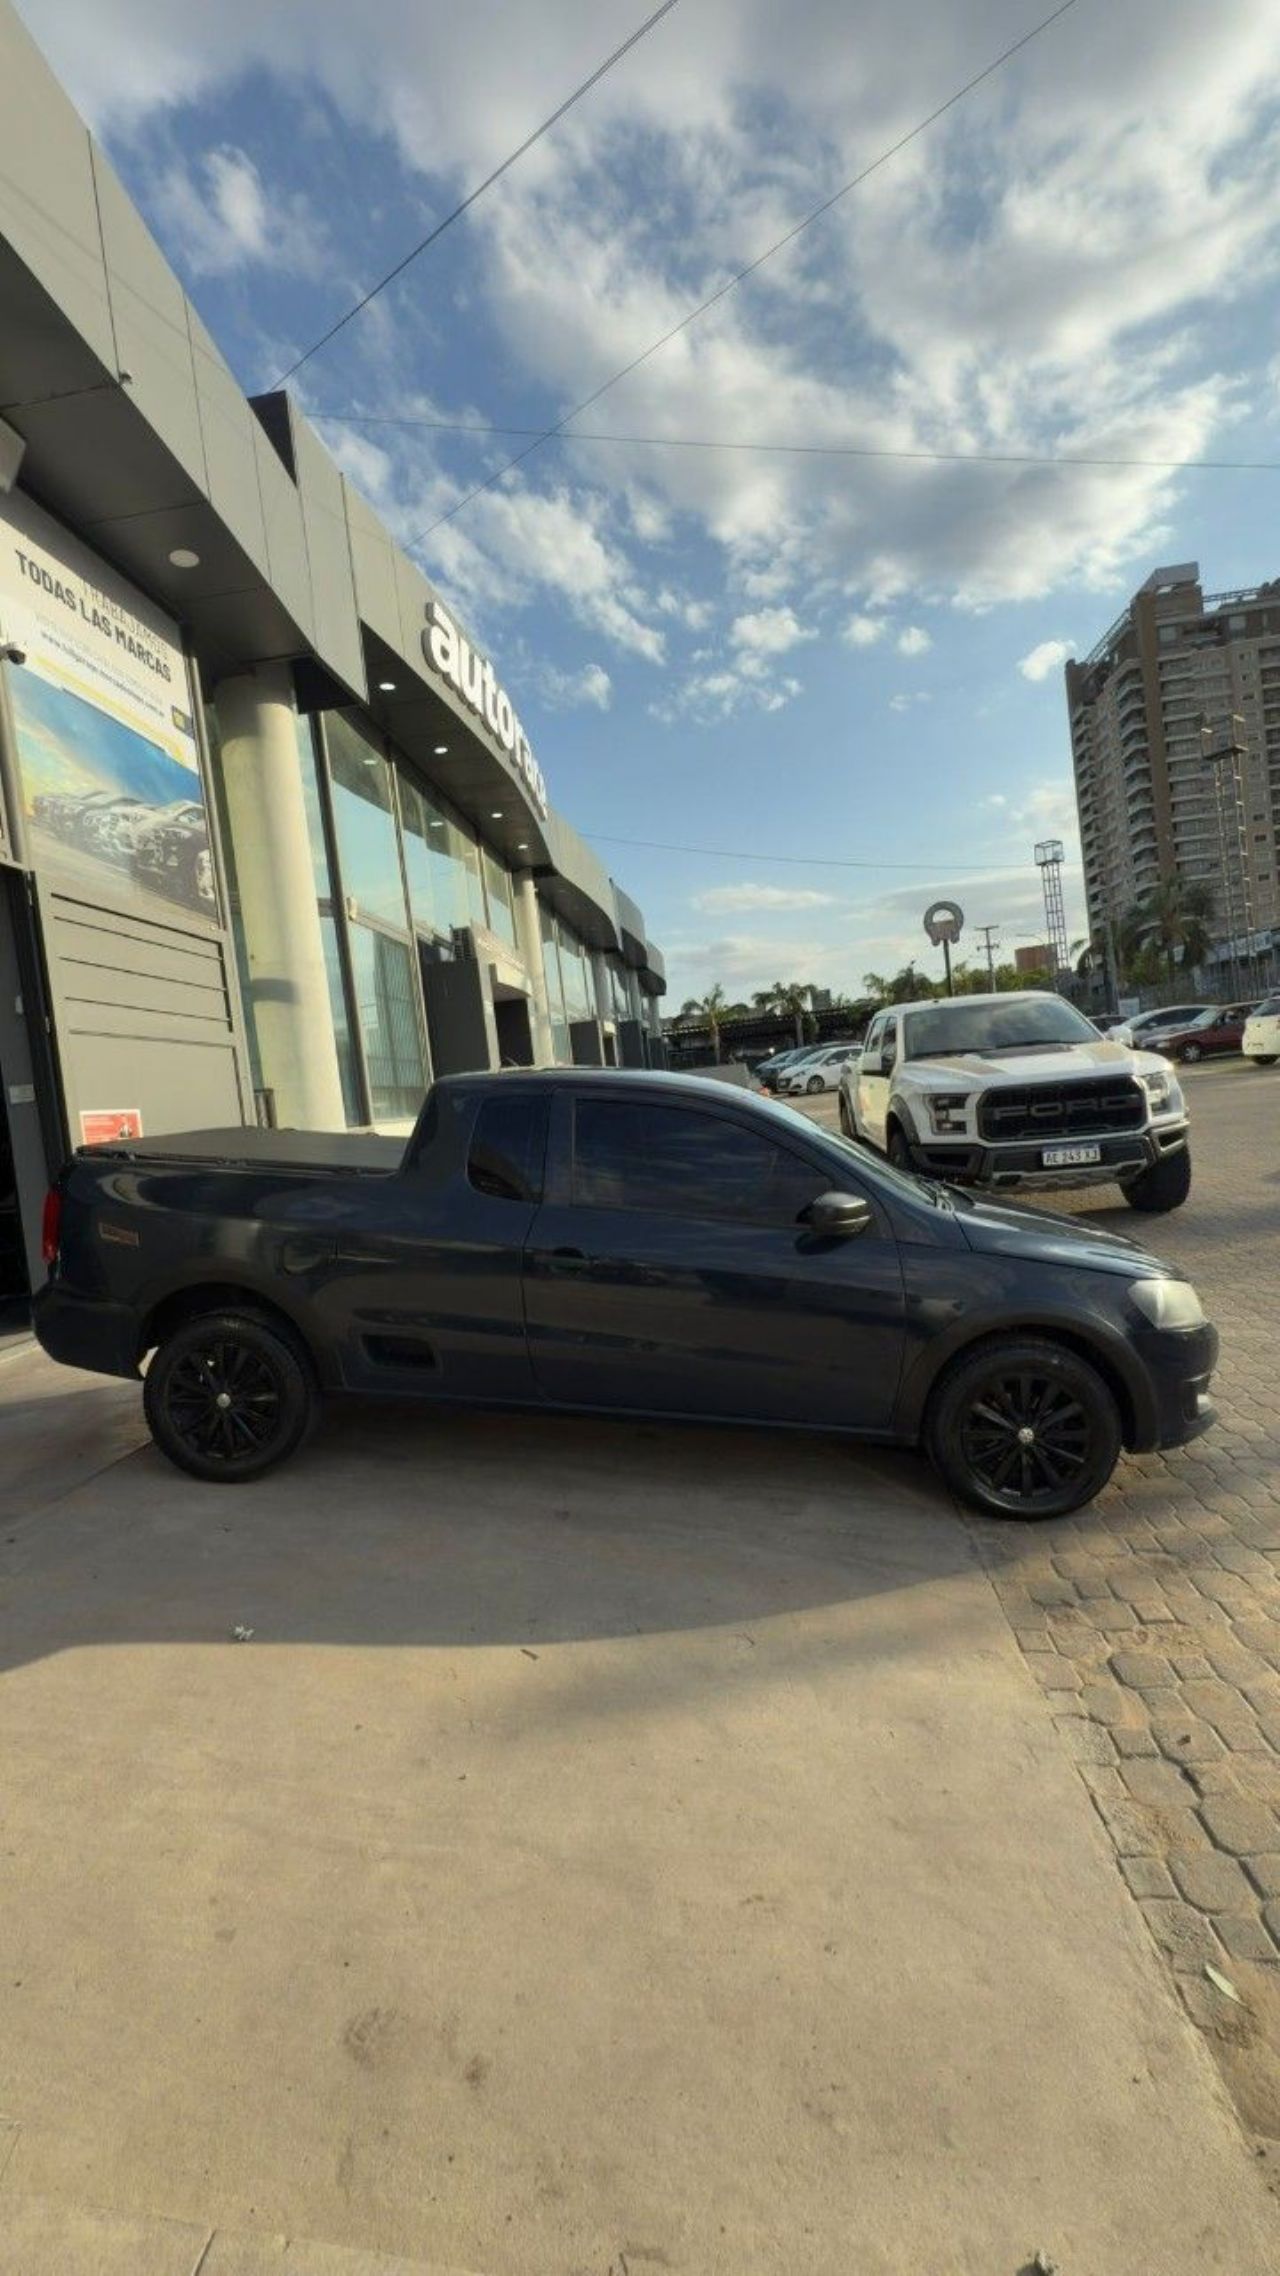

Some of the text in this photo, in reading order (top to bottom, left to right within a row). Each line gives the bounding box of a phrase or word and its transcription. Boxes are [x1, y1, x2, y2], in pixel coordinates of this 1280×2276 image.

[15, 549, 77, 612] TODAS
[79, 598, 112, 638] LAS
[115, 626, 172, 683] MARCAS
[993, 1094, 1140, 1121] FORD
